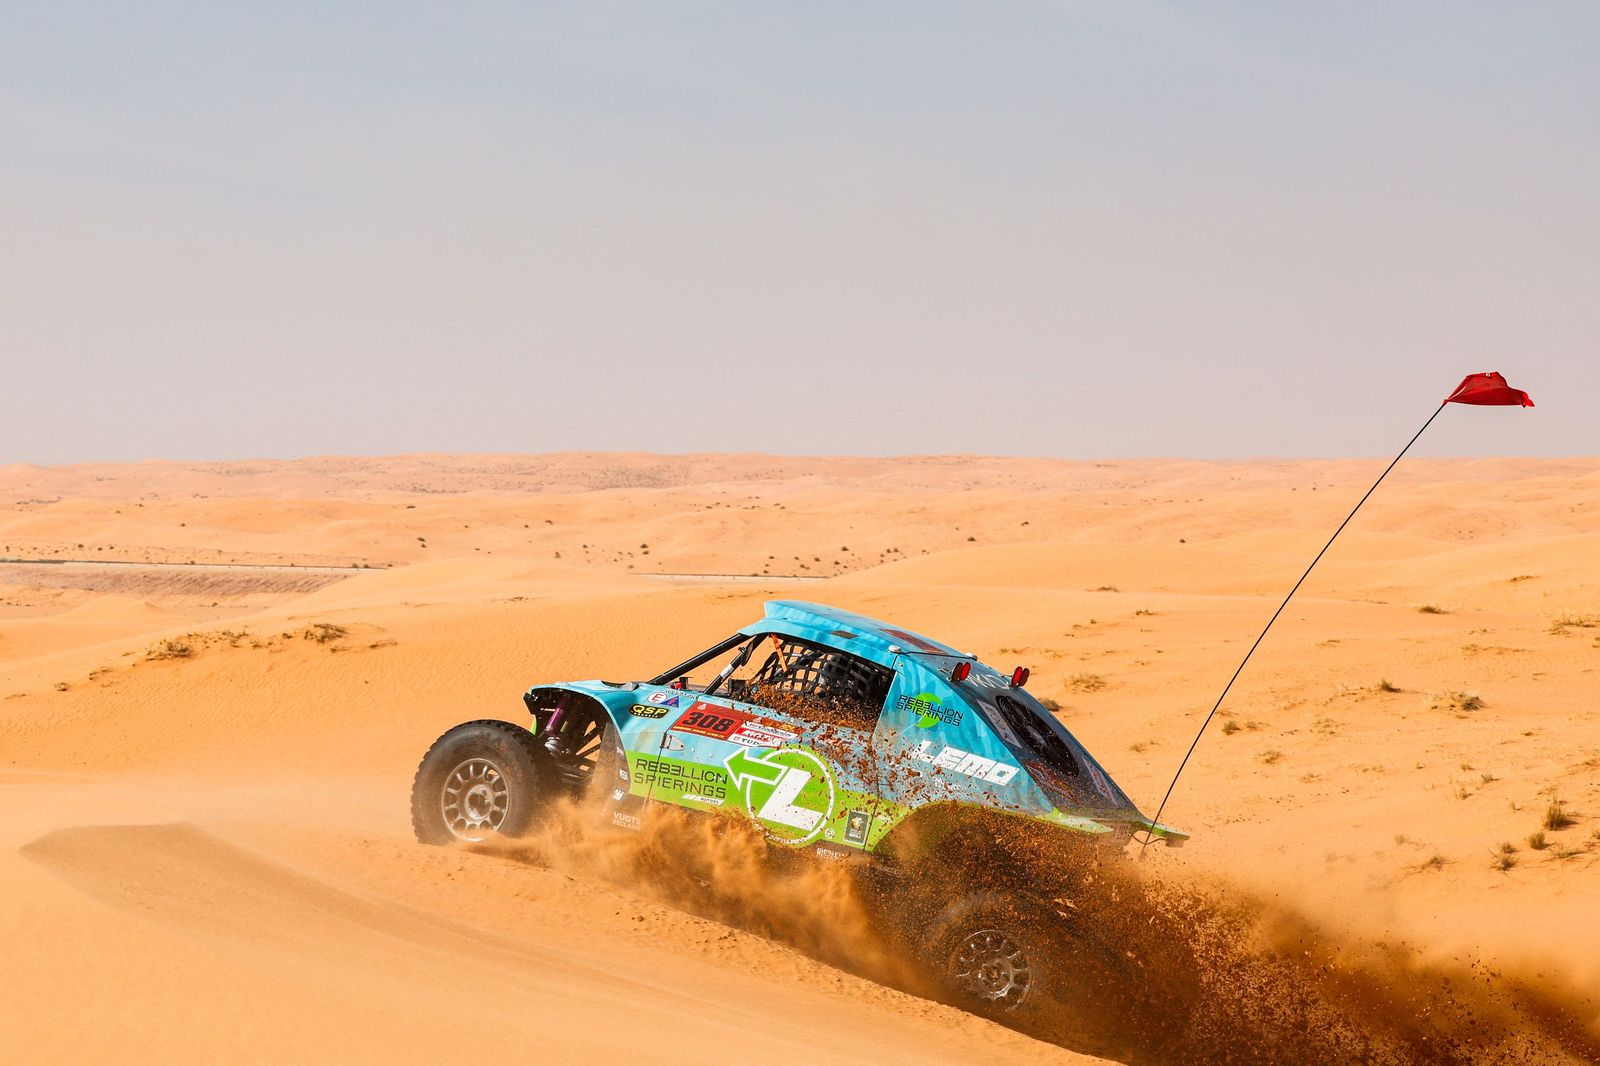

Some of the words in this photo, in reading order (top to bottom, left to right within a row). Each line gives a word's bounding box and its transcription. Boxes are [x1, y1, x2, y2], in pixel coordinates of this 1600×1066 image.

[633, 705, 667, 717] QSP
[682, 711, 735, 733] 308
[895, 701, 961, 727] SPIERINGS
[912, 739, 1021, 787] LEMO
[633, 772, 727, 799] SPIERINGS
